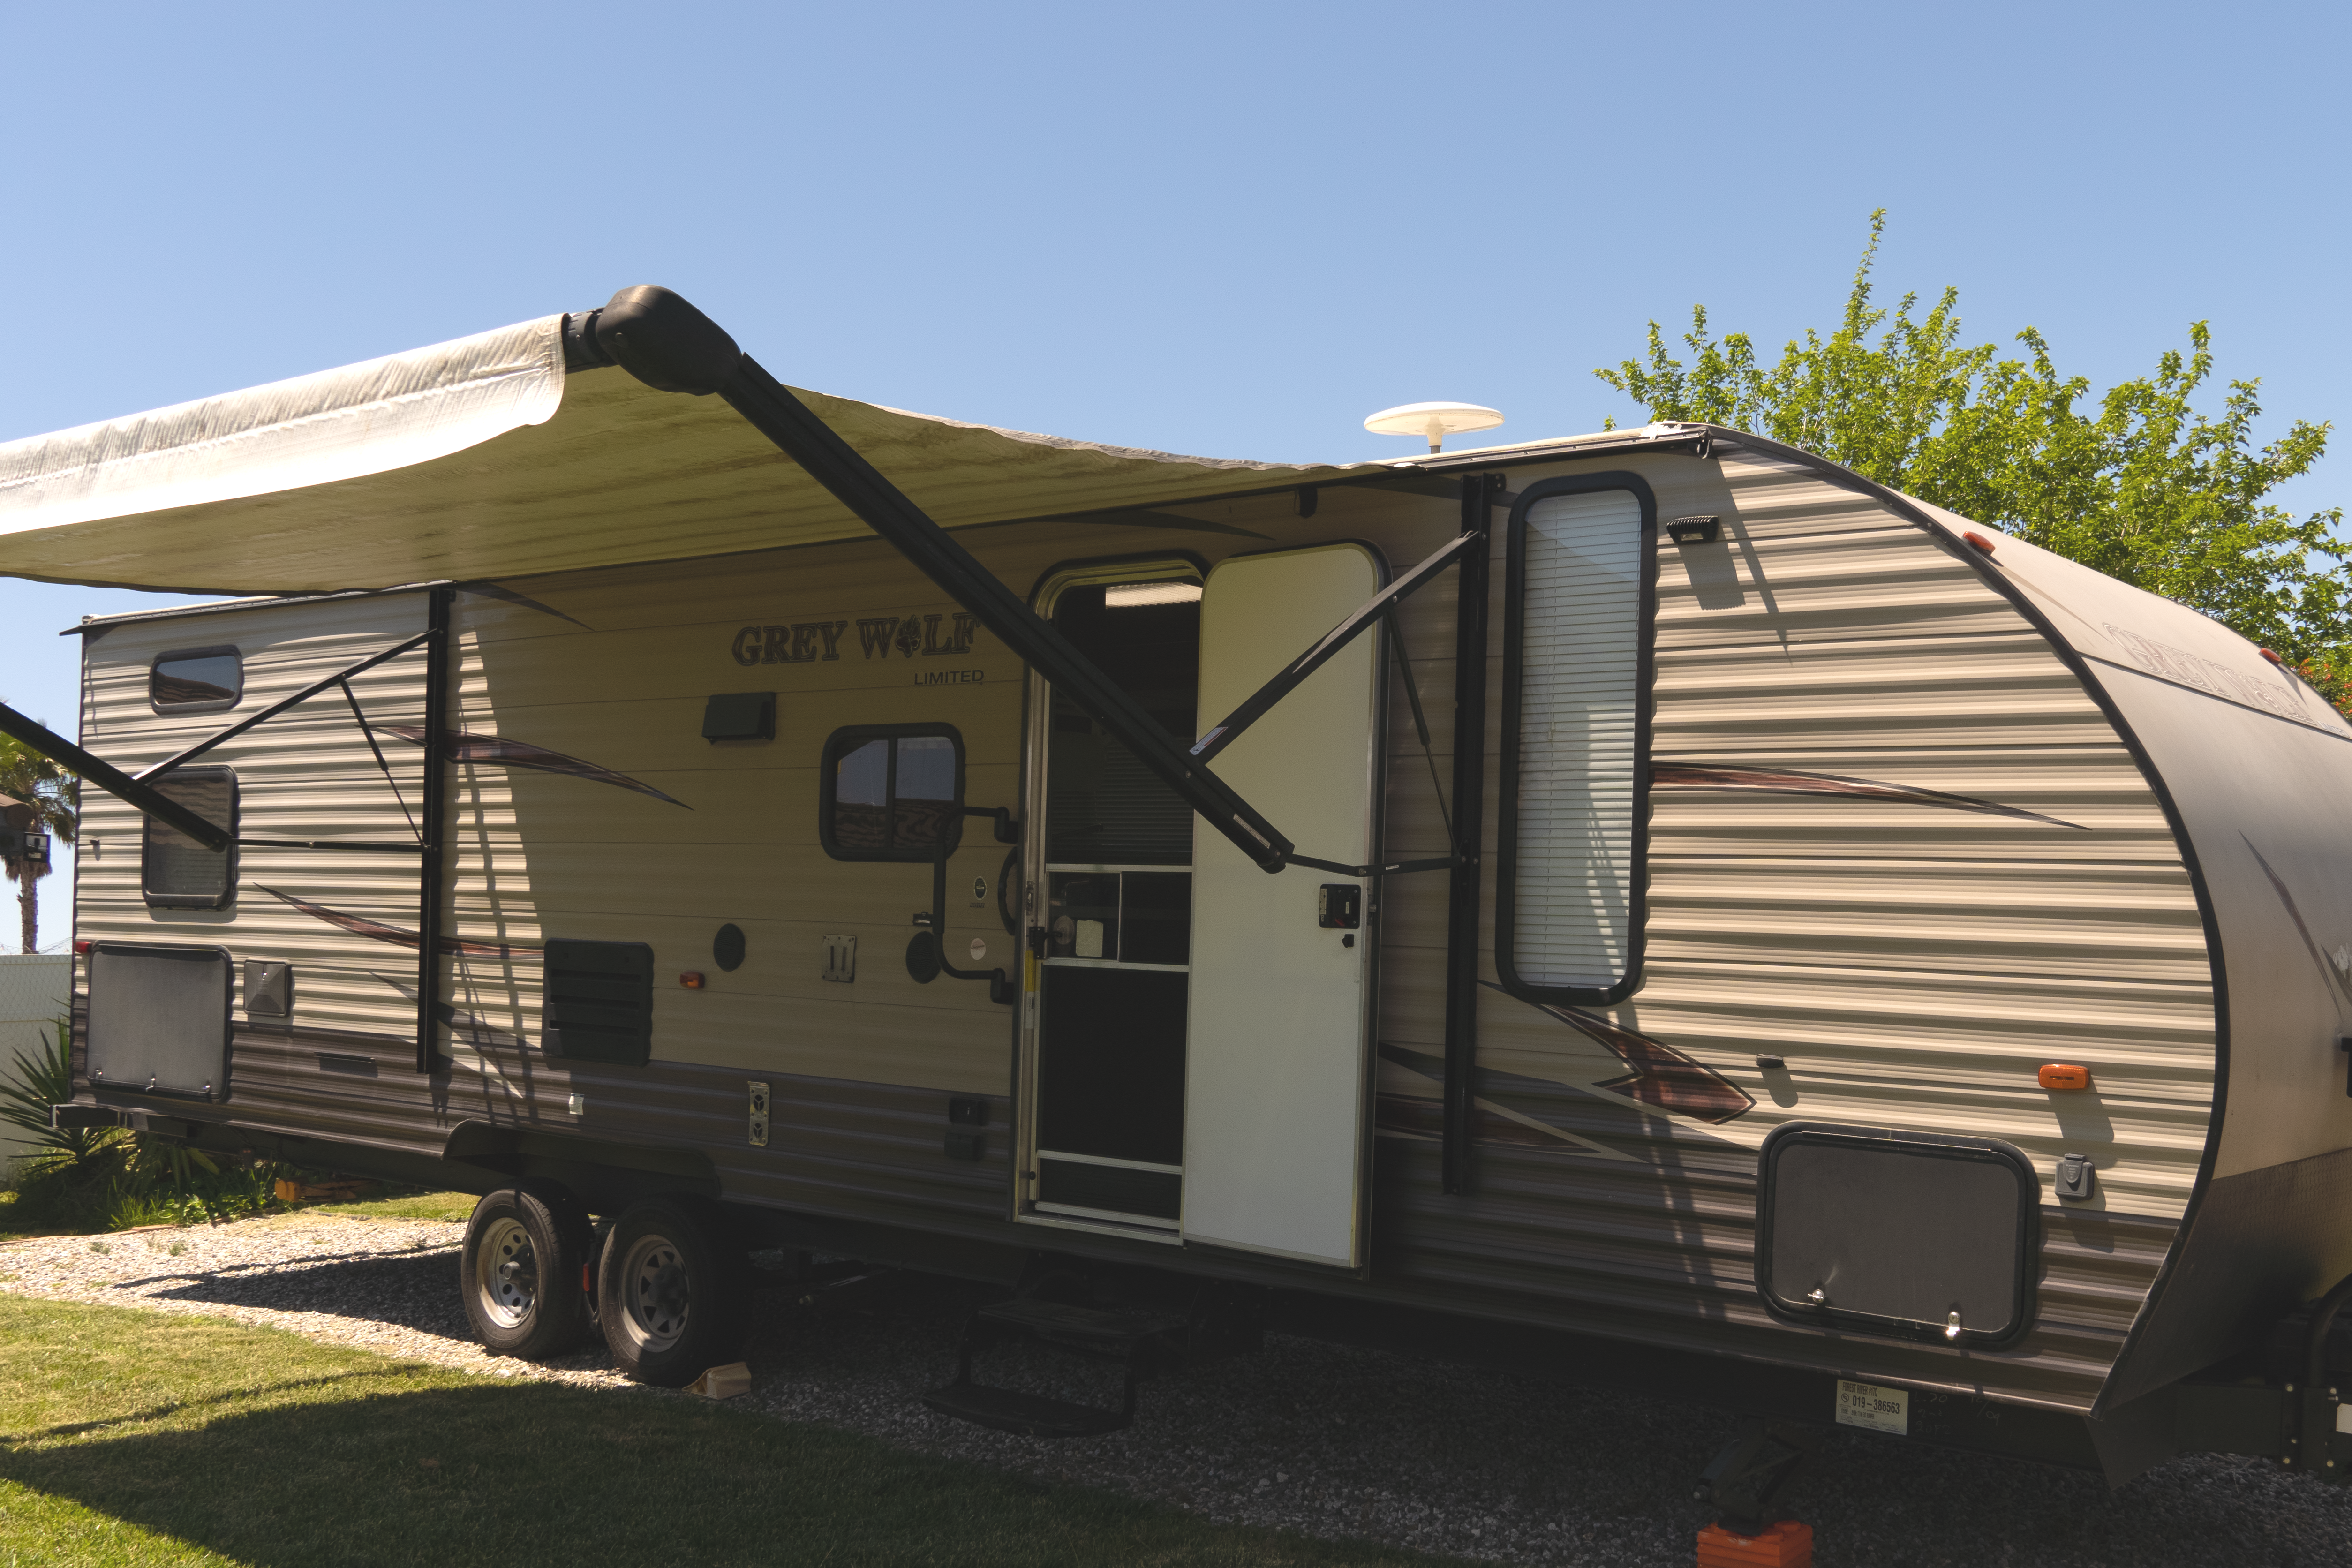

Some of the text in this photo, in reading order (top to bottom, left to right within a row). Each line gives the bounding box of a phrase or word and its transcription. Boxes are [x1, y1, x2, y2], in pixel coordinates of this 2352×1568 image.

[731, 620, 848, 666] GREY
[914, 670, 984, 685] LIMITED
[1842, 1381, 1856, 1393] FOREST
[1857, 1384, 1868, 1395] RIVER
